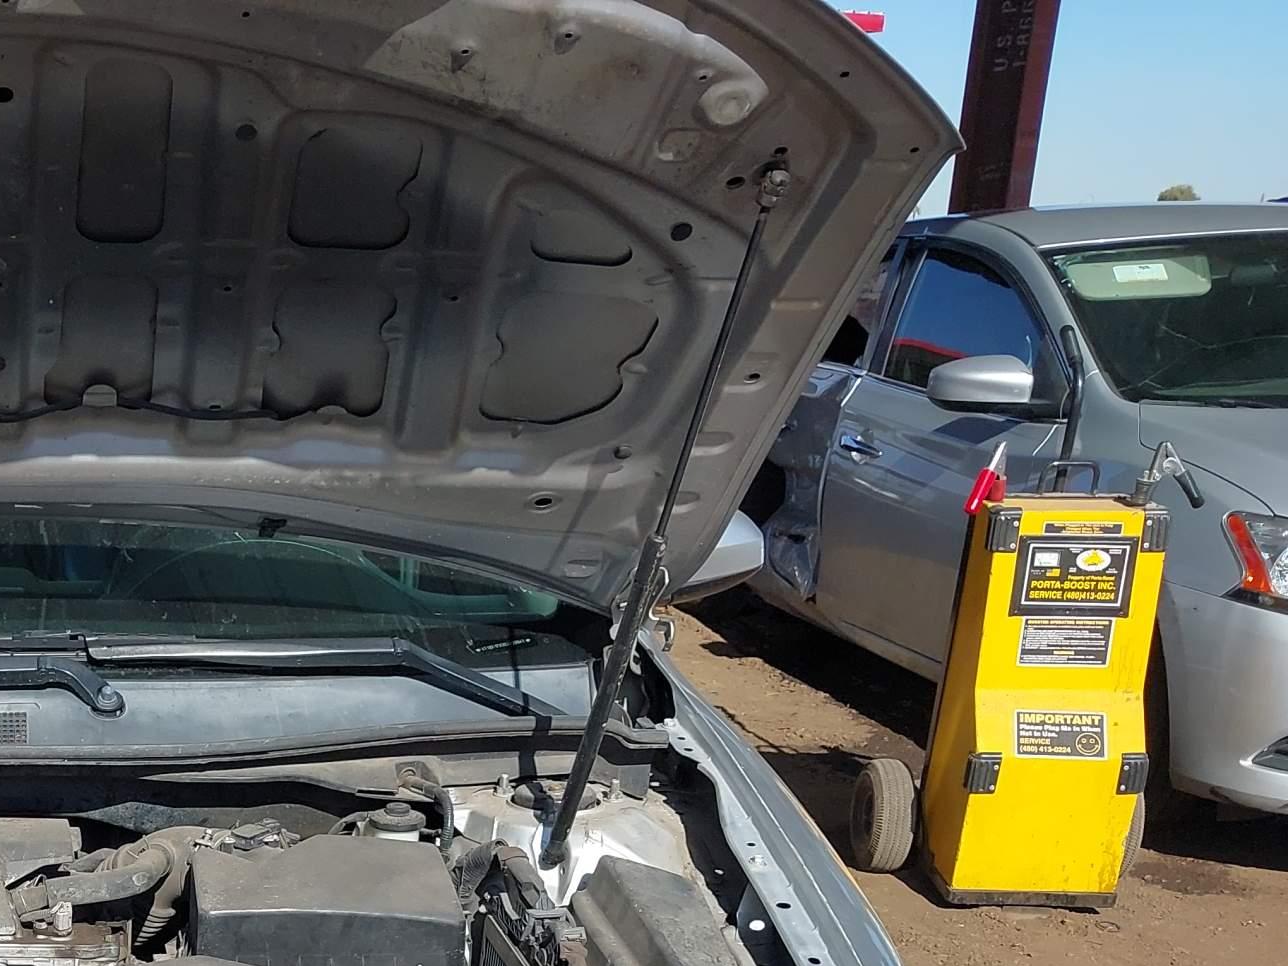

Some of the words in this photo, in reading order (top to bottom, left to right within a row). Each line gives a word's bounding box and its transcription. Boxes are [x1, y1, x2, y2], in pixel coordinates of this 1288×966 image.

[1031, 580, 1096, 589] PORTA-BOOST
[1098, 582, 1116, 590] INC.
[1029, 591, 1063, 599] SERVICE
[1063, 592, 1115, 600] (480)413-0224
[1019, 714, 1101, 725] IMPORTANT
[1019, 745, 1038, 753] (480)
